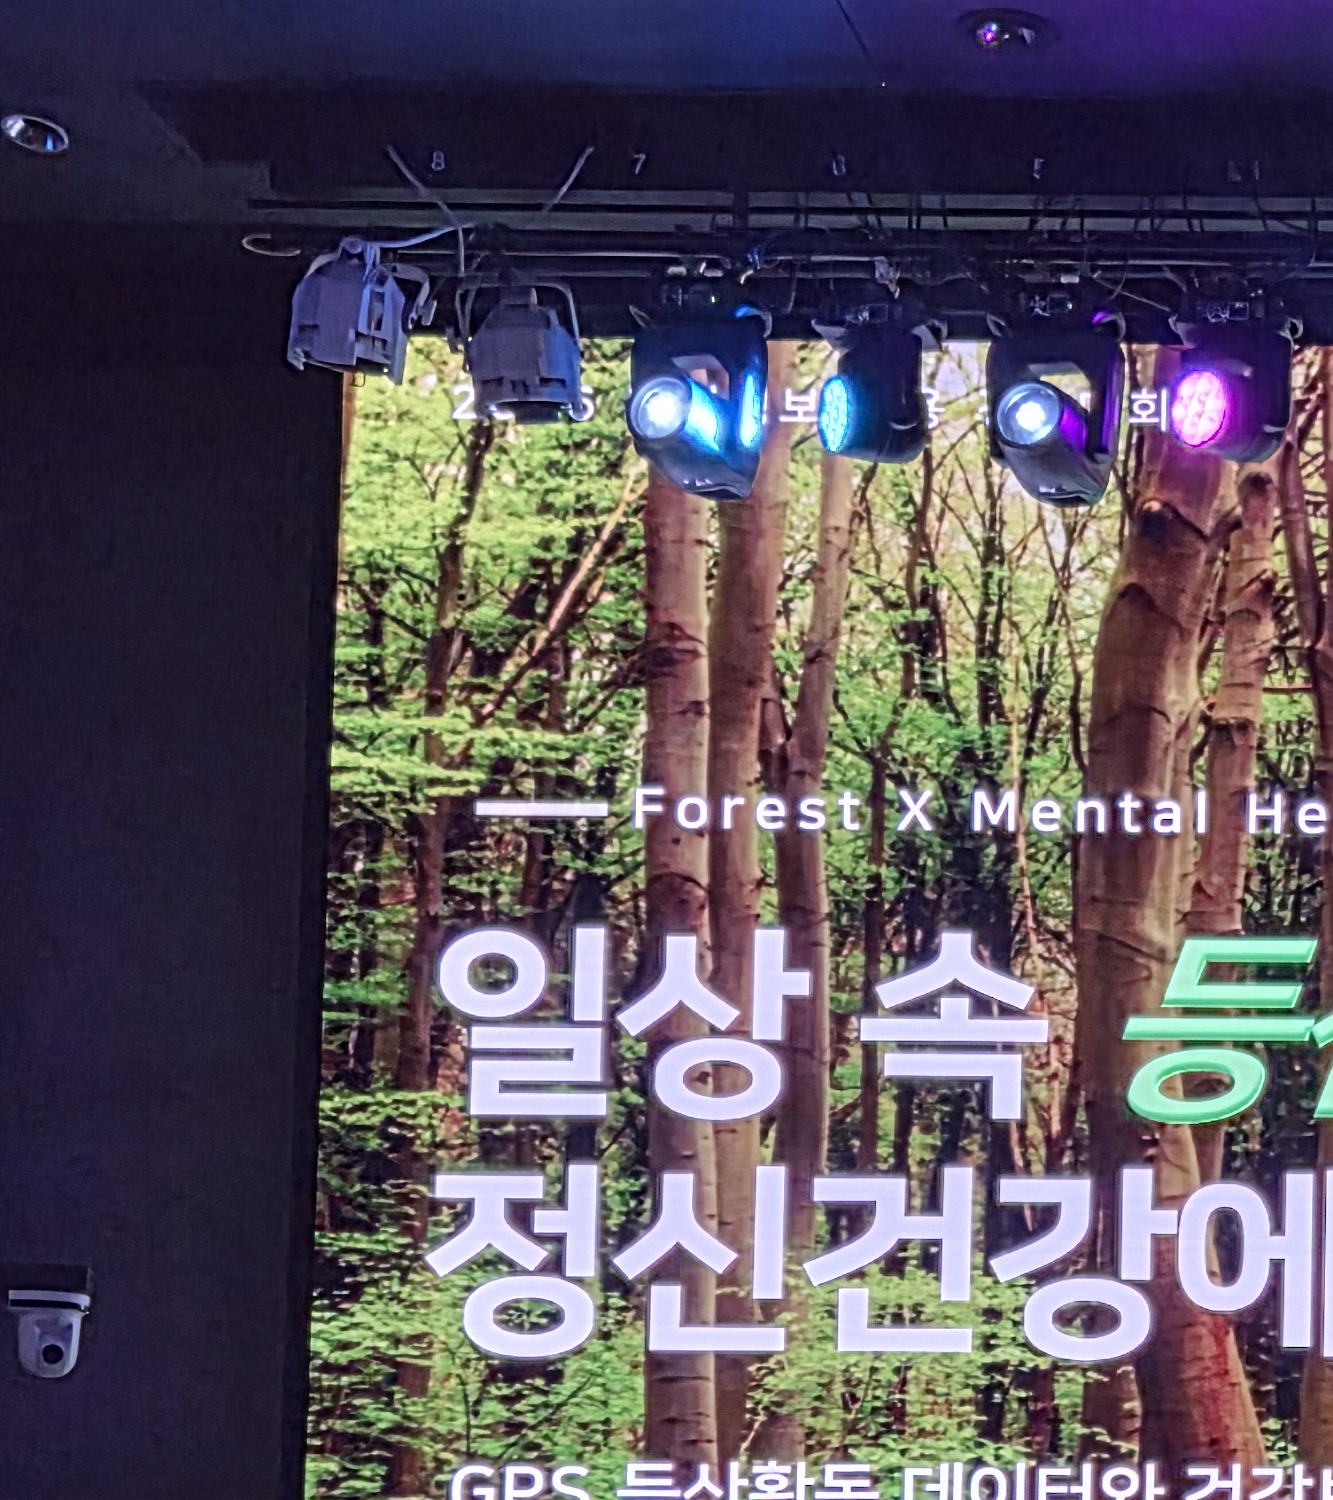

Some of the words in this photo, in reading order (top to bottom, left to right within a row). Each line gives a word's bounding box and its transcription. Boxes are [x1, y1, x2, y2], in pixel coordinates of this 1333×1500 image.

[633, 153, 647, 175] 7
[632, 787, 860, 832] Forest
[897, 790, 934, 832] X
[971, 790, 1207, 835] Mental
[437, 925, 810, 1122] 일상
[859, 931, 1049, 1122] 속
